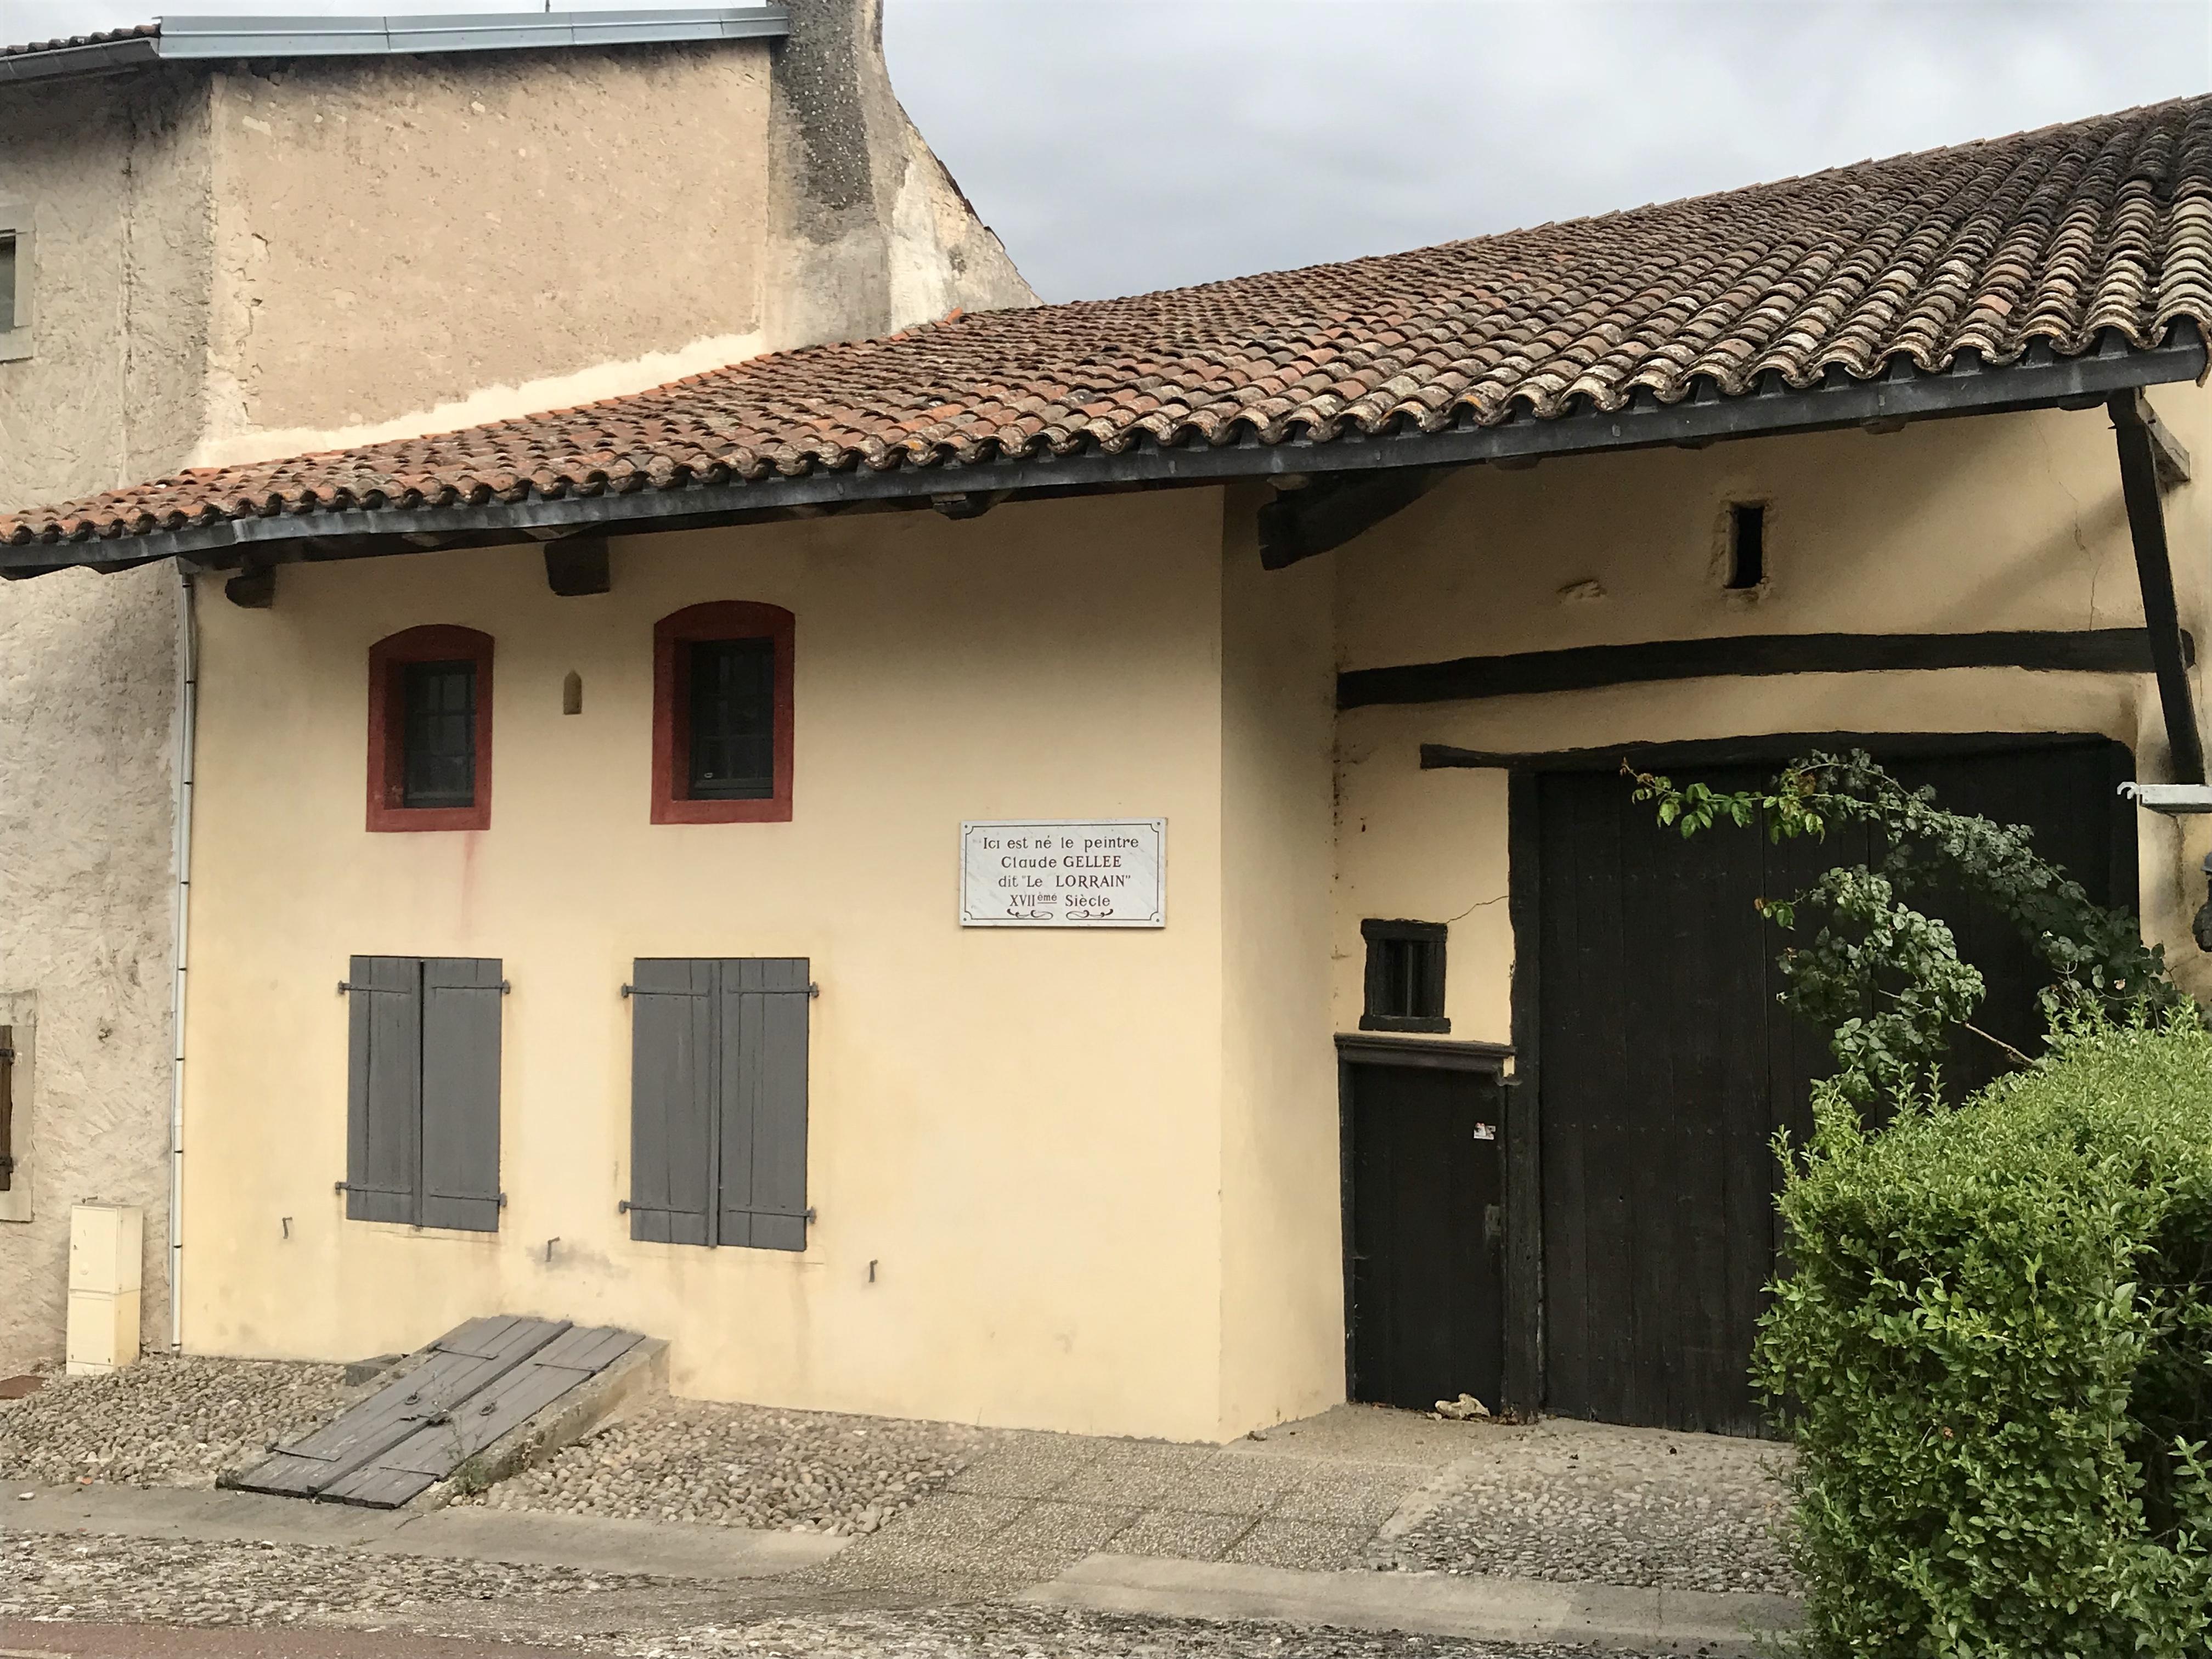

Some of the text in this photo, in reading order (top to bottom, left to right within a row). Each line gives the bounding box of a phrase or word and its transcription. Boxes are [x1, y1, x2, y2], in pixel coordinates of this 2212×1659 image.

[983, 834, 1139, 853] Ici est né le peintre
[1001, 855, 1122, 868] Claude GELLEE
[998, 875, 1019, 888] dit
[1065, 894, 1110, 907] Siècle
